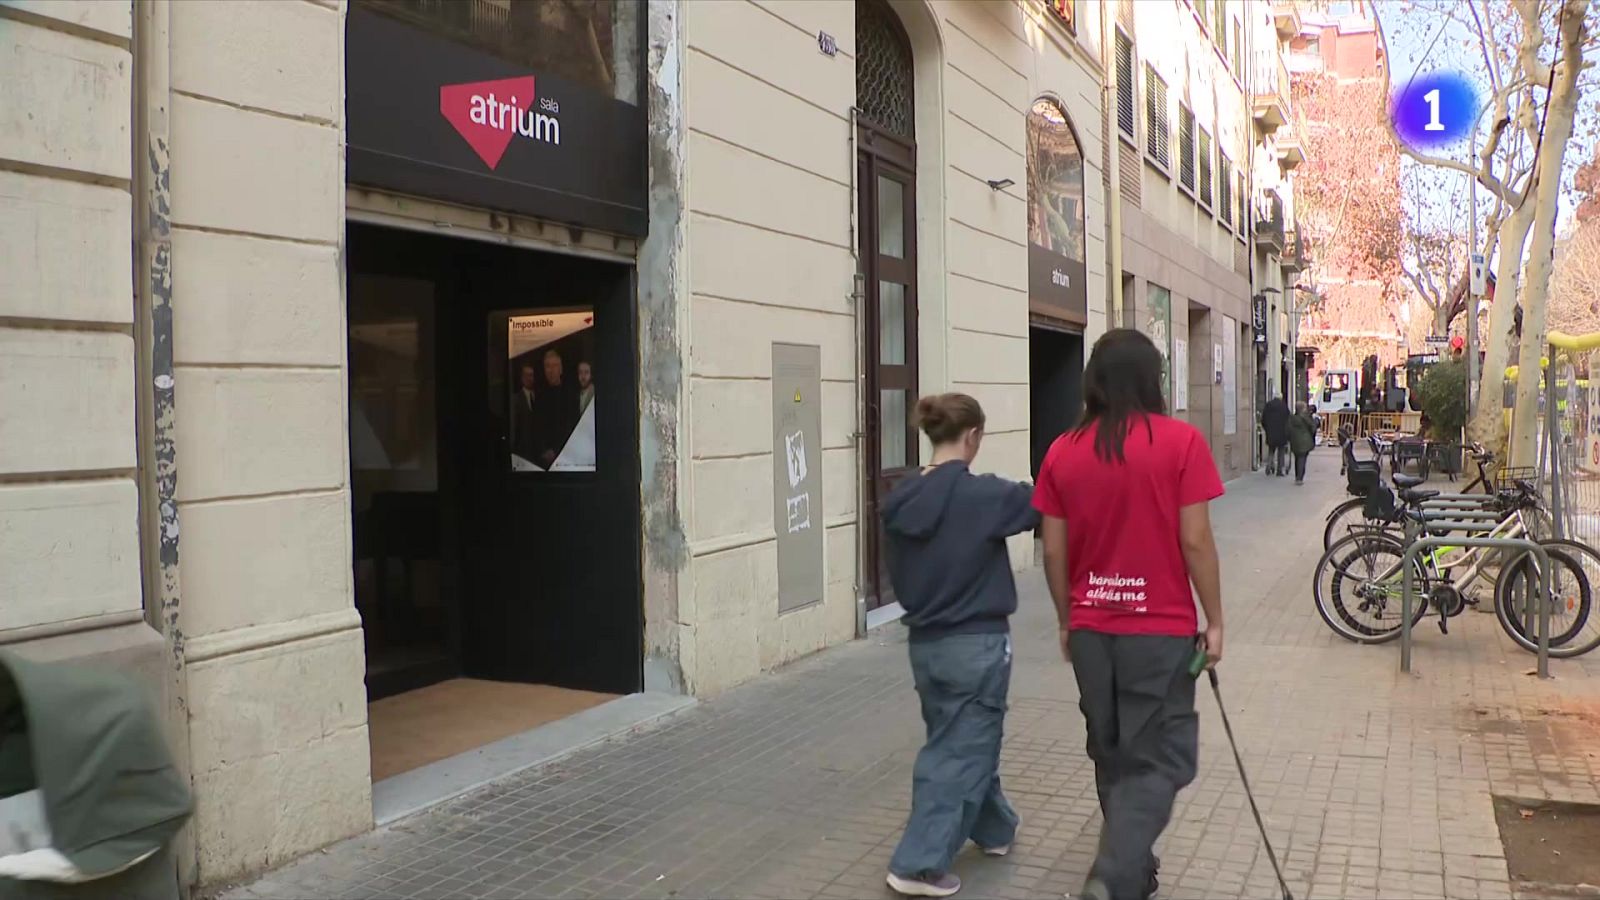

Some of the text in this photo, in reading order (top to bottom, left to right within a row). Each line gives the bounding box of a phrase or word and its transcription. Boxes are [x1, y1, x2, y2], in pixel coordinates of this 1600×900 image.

[540, 97, 559, 113] sala
[469, 93, 560, 145] atrium
[1052, 268, 1070, 288] atrium
[512, 318, 554, 331] Impossible
